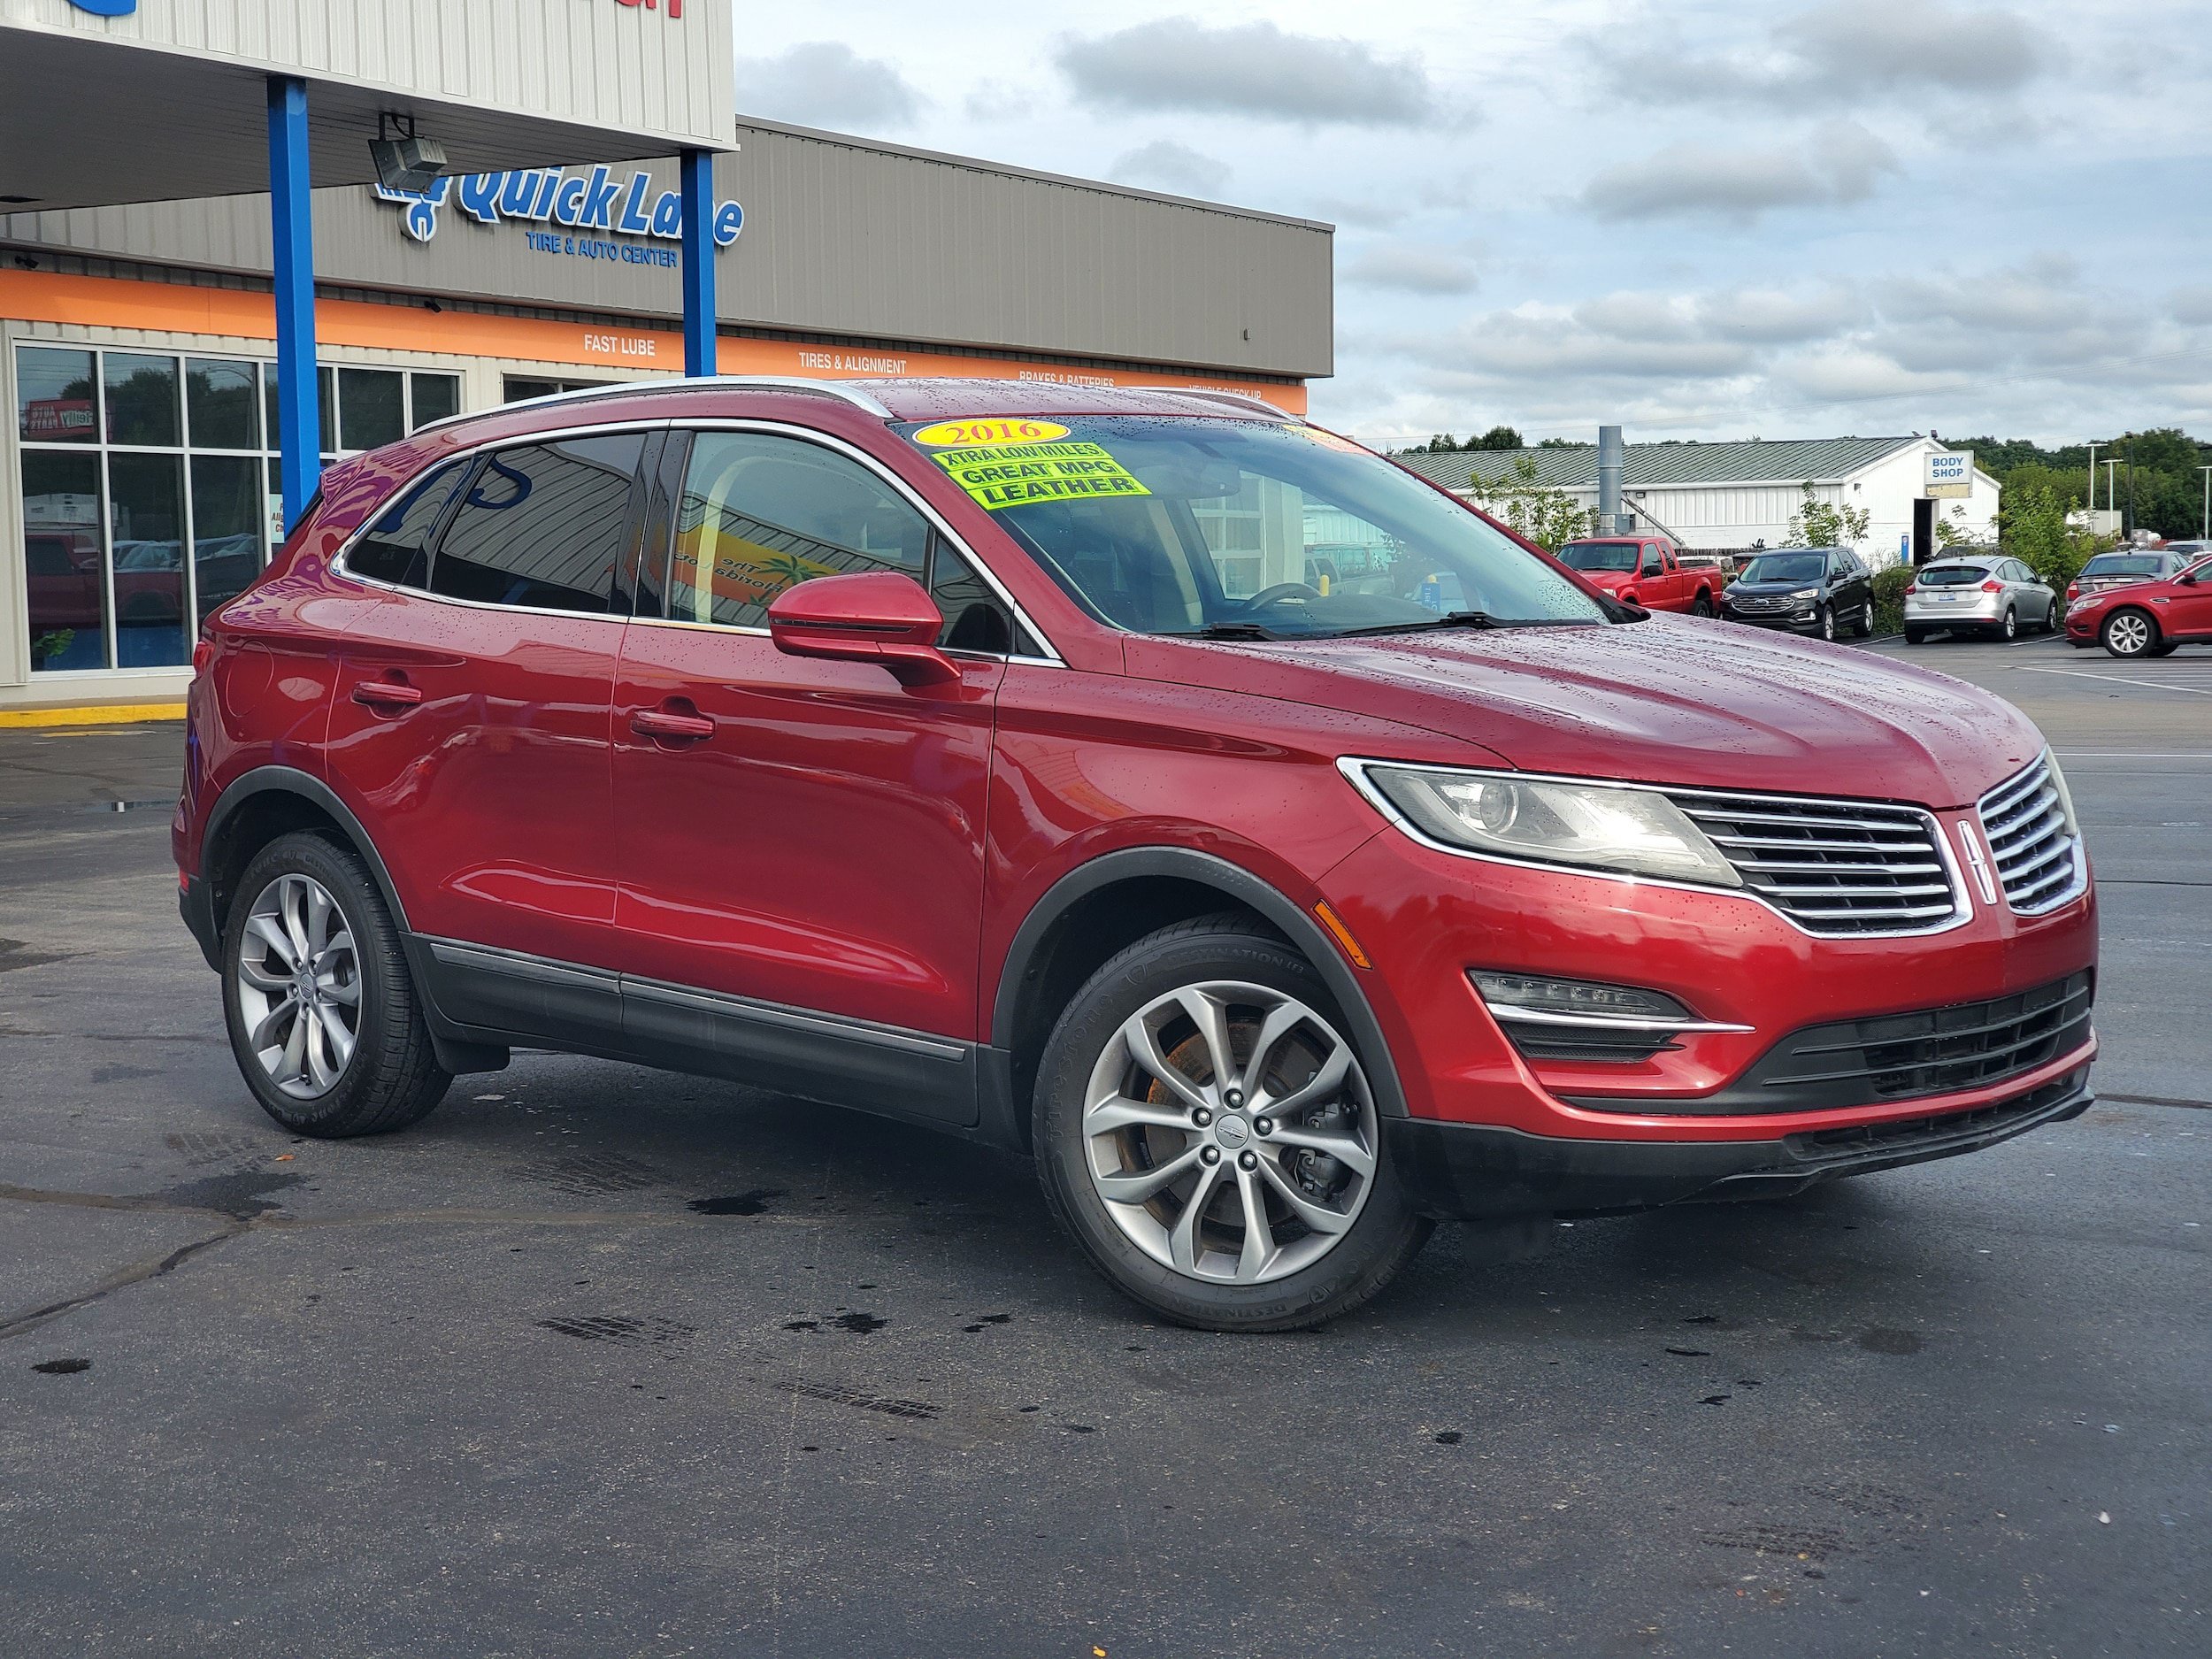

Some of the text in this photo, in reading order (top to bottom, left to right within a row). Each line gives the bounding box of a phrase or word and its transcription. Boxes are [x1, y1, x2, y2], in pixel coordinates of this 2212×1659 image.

[459, 164, 745, 247] Quick Lae
[526, 231, 679, 268] TIRE & AUTO CENTER
[584, 334, 656, 356] FAST LUBE
[799, 351, 907, 375] TIRES & ALIGNMENT
[1019, 370, 1056, 383] BRAKES
[1067, 374, 1115, 388] BATTERIES
[945, 422, 1042, 444] 2016
[940, 444, 1100, 467] XTRA LOW MILES
[1932, 457, 1964, 467] BODY
[961, 461, 1118, 484] GREAT MPG
[1932, 468, 1964, 478] SHOP
[981, 477, 1134, 504] LEATHER
[1167, 947, 1284, 967] DESTINATION
